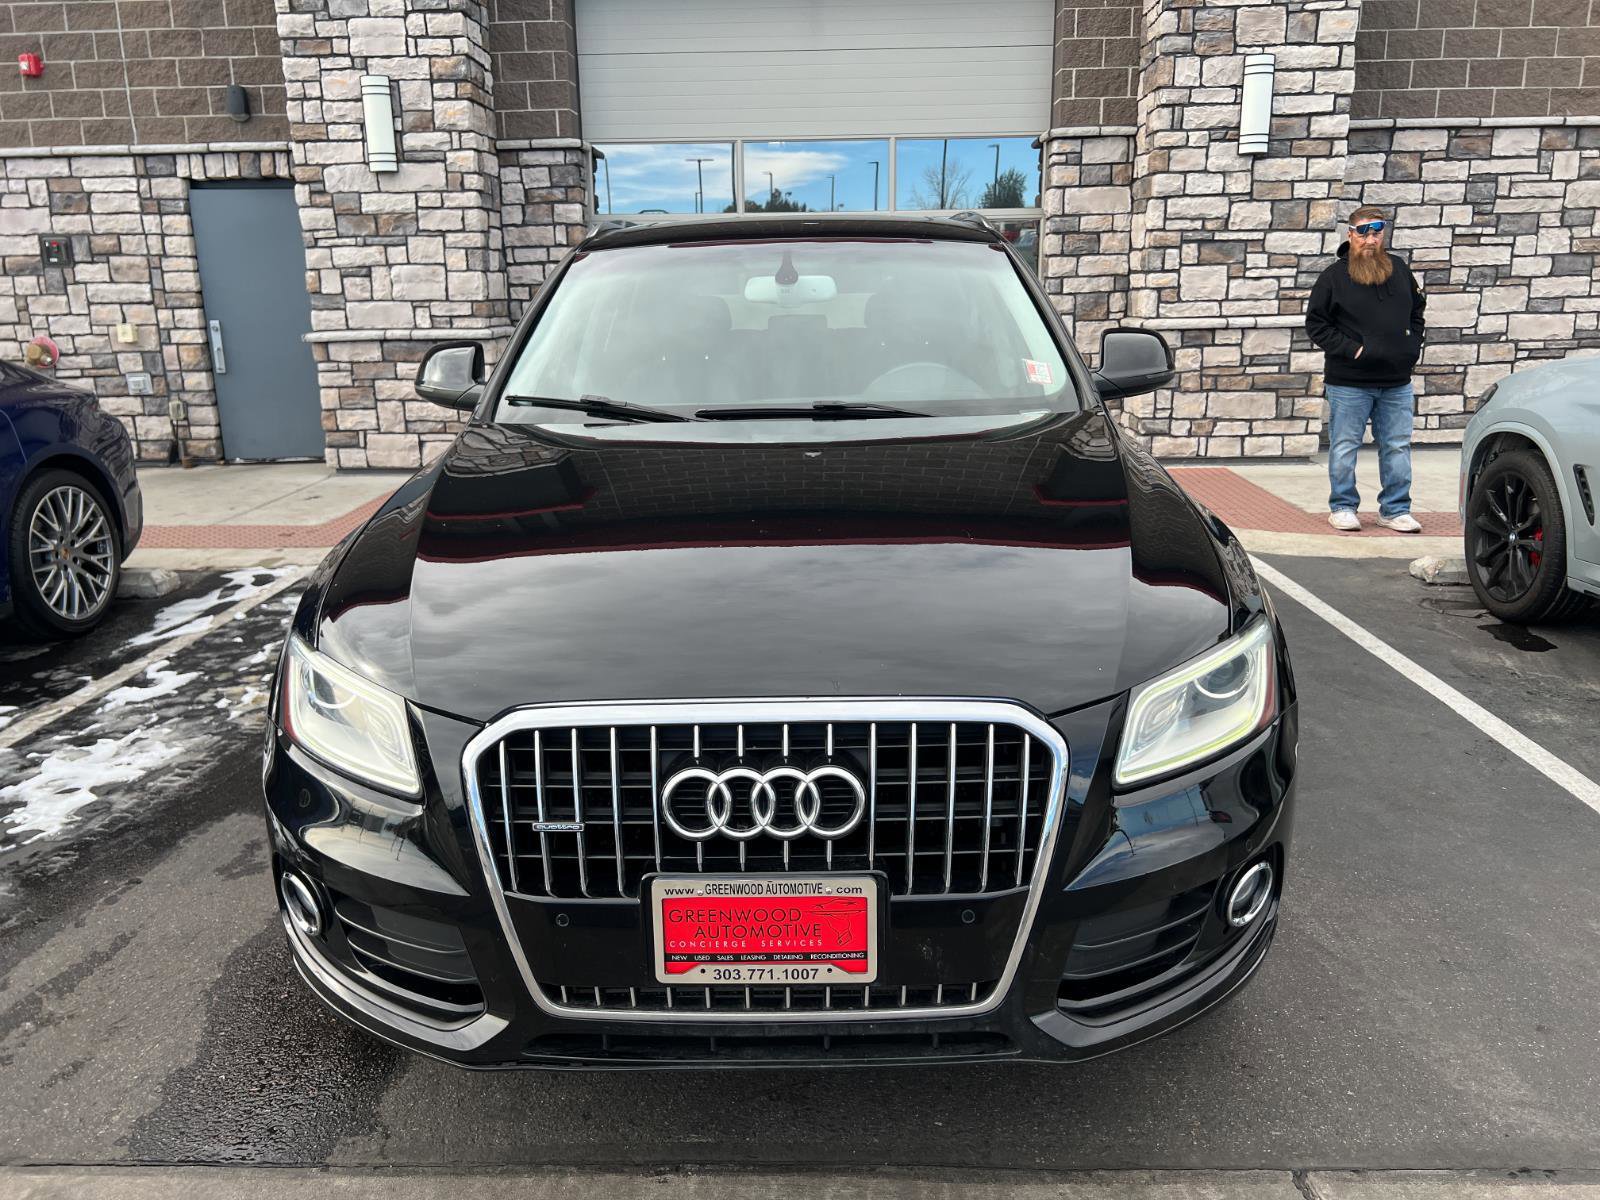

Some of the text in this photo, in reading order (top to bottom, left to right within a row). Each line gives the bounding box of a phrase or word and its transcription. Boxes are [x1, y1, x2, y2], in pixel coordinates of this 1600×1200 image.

[704, 883, 764, 896] GREENWOOD
[766, 883, 823, 895] AUTOMOTIVE
[668, 908, 802, 923] GREENWOOD
[694, 924, 822, 939] AUTOMOTIVE
[713, 968, 819, 981] 303.771.1007
